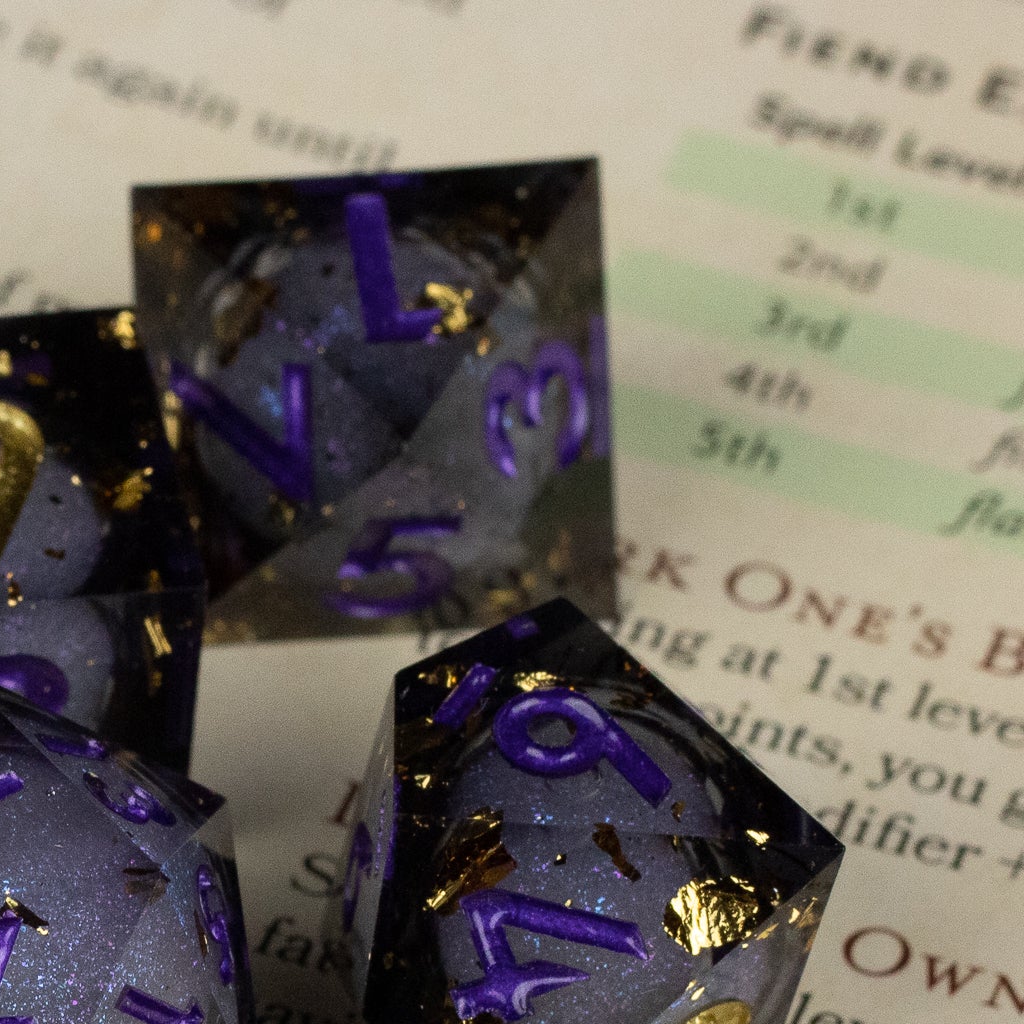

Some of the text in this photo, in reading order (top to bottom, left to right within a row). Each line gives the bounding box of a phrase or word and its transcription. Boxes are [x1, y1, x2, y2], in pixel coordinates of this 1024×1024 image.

[724, 362, 814, 413] 4th
[691, 417, 783, 477] 5th
[719, 643, 781, 682] at
[806, 652, 893, 715] 1st
[864, 750, 989, 808] you
